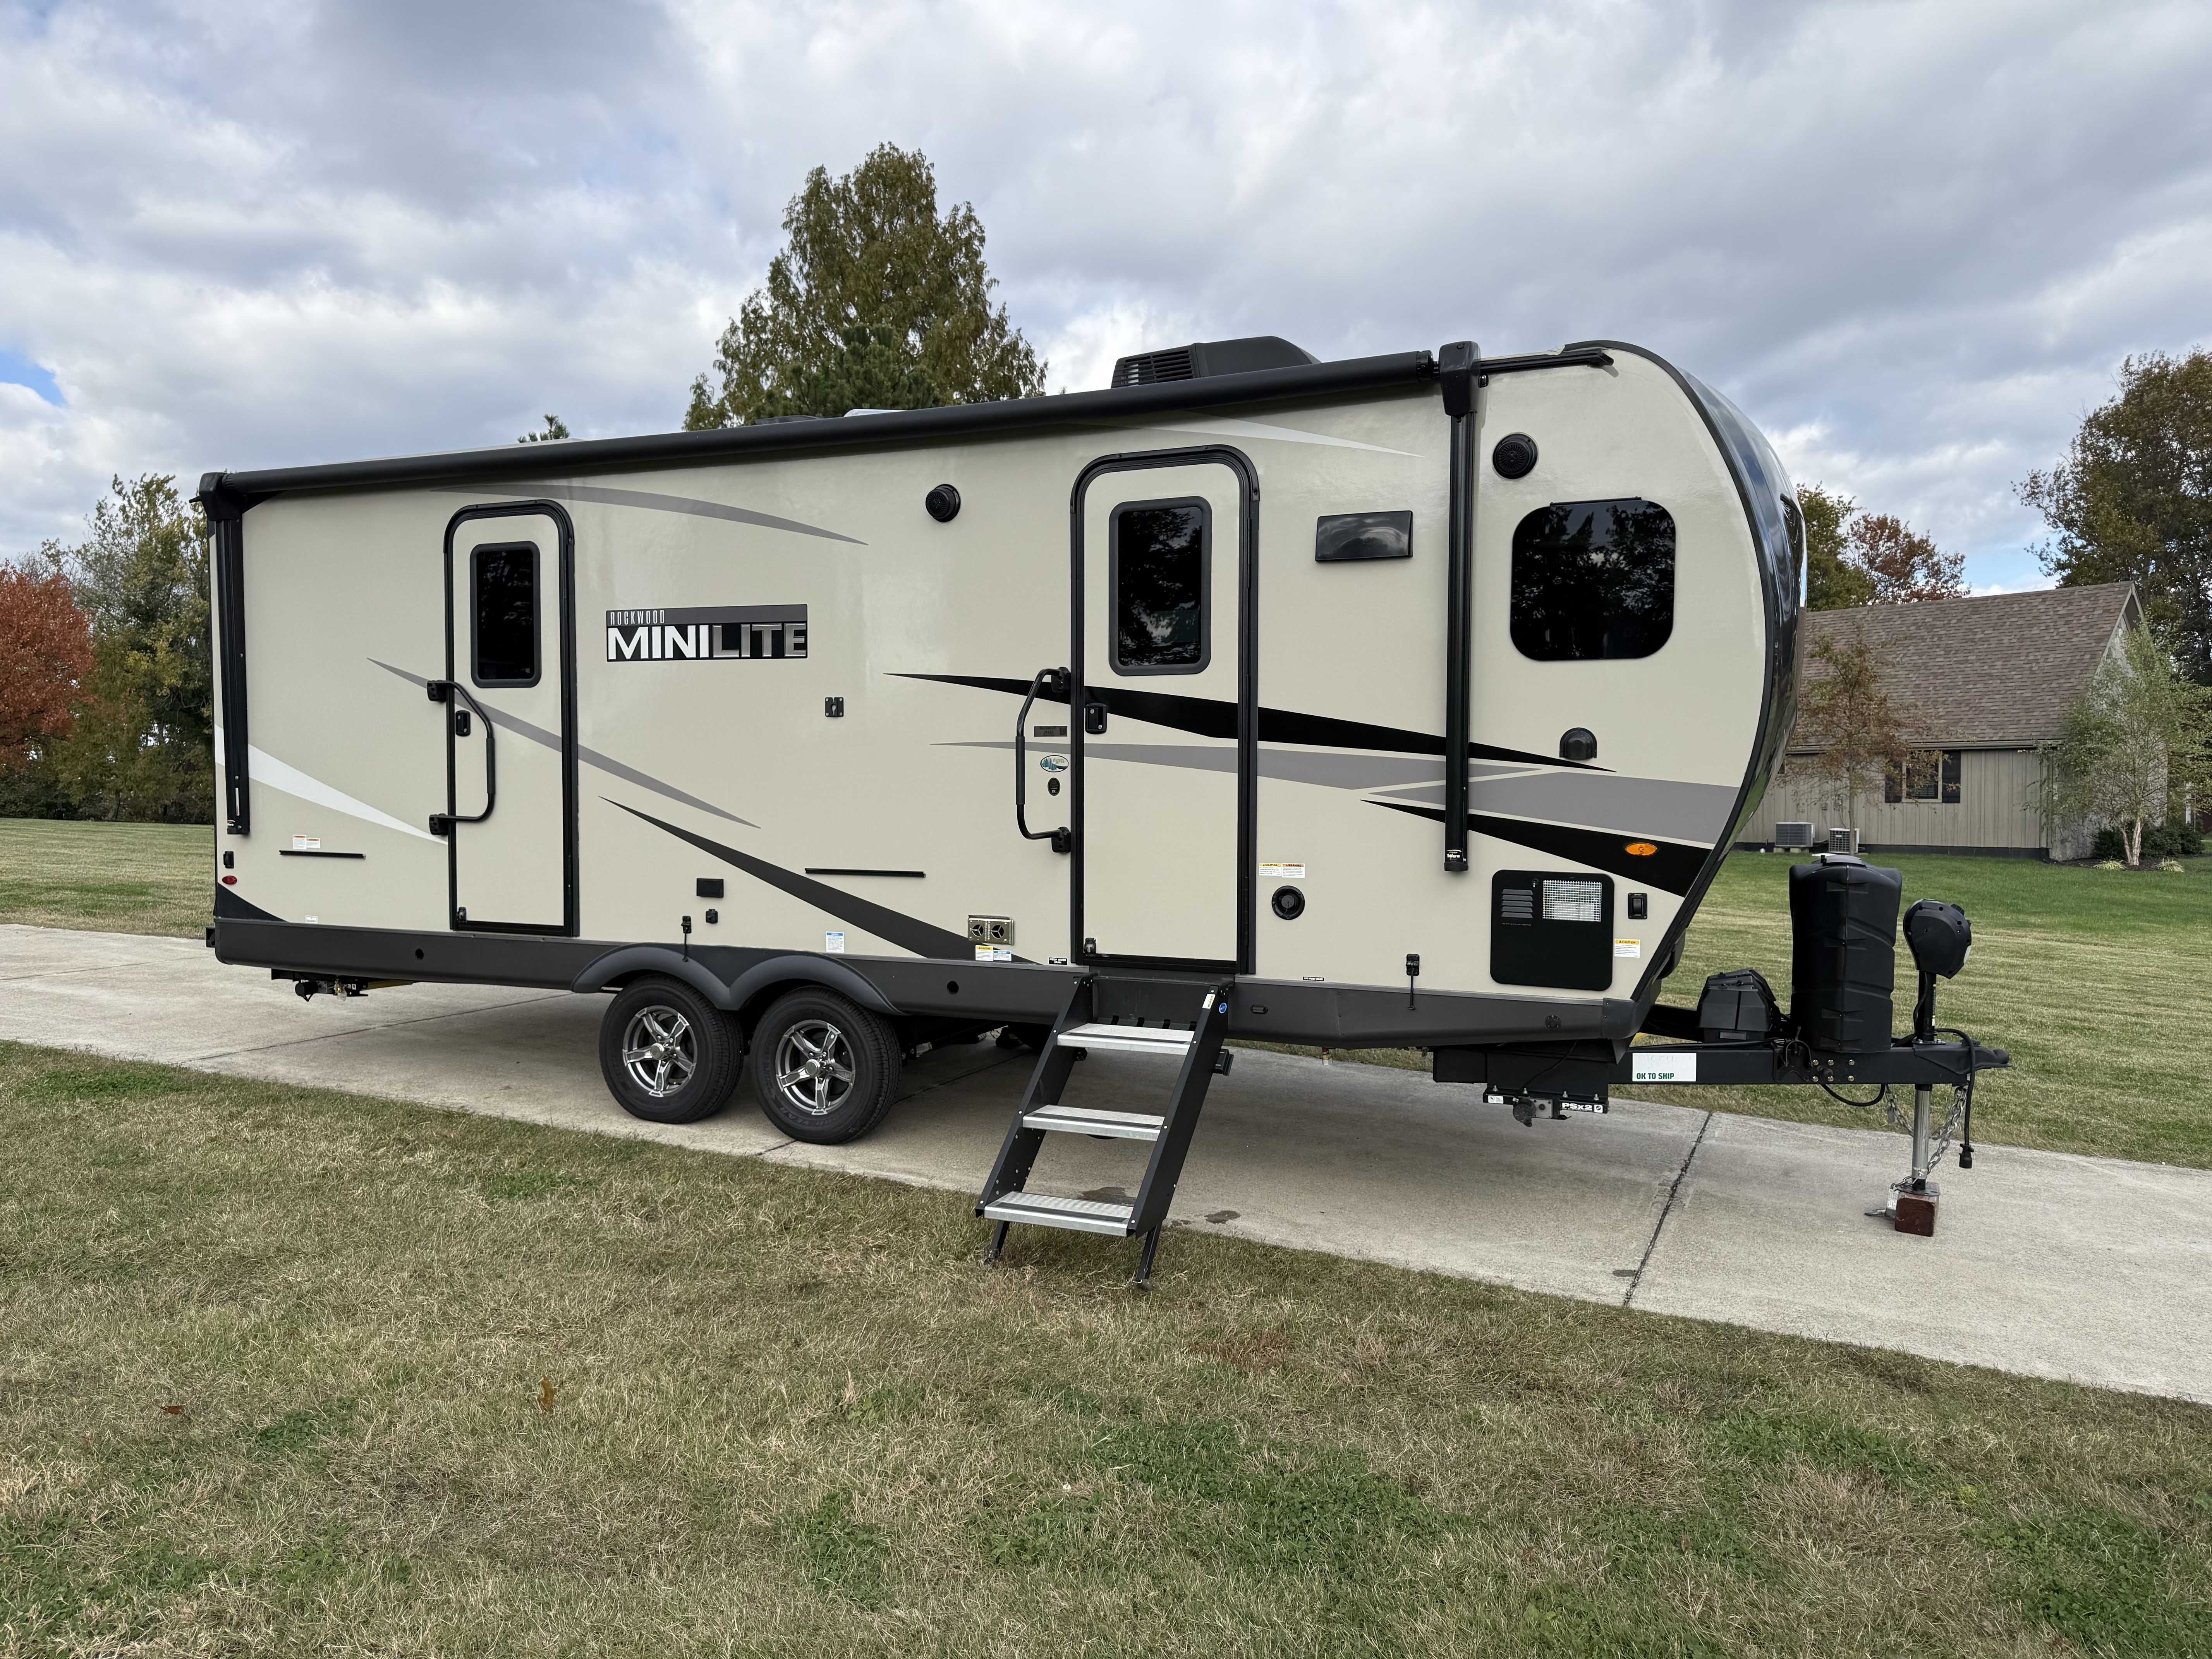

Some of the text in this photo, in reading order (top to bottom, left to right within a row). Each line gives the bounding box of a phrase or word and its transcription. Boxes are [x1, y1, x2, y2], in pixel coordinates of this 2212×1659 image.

[610, 610, 665, 625] ROCKWOOD
[608, 623, 806, 659] MINILITE
[1562, 1102, 1592, 1110] PSx2
